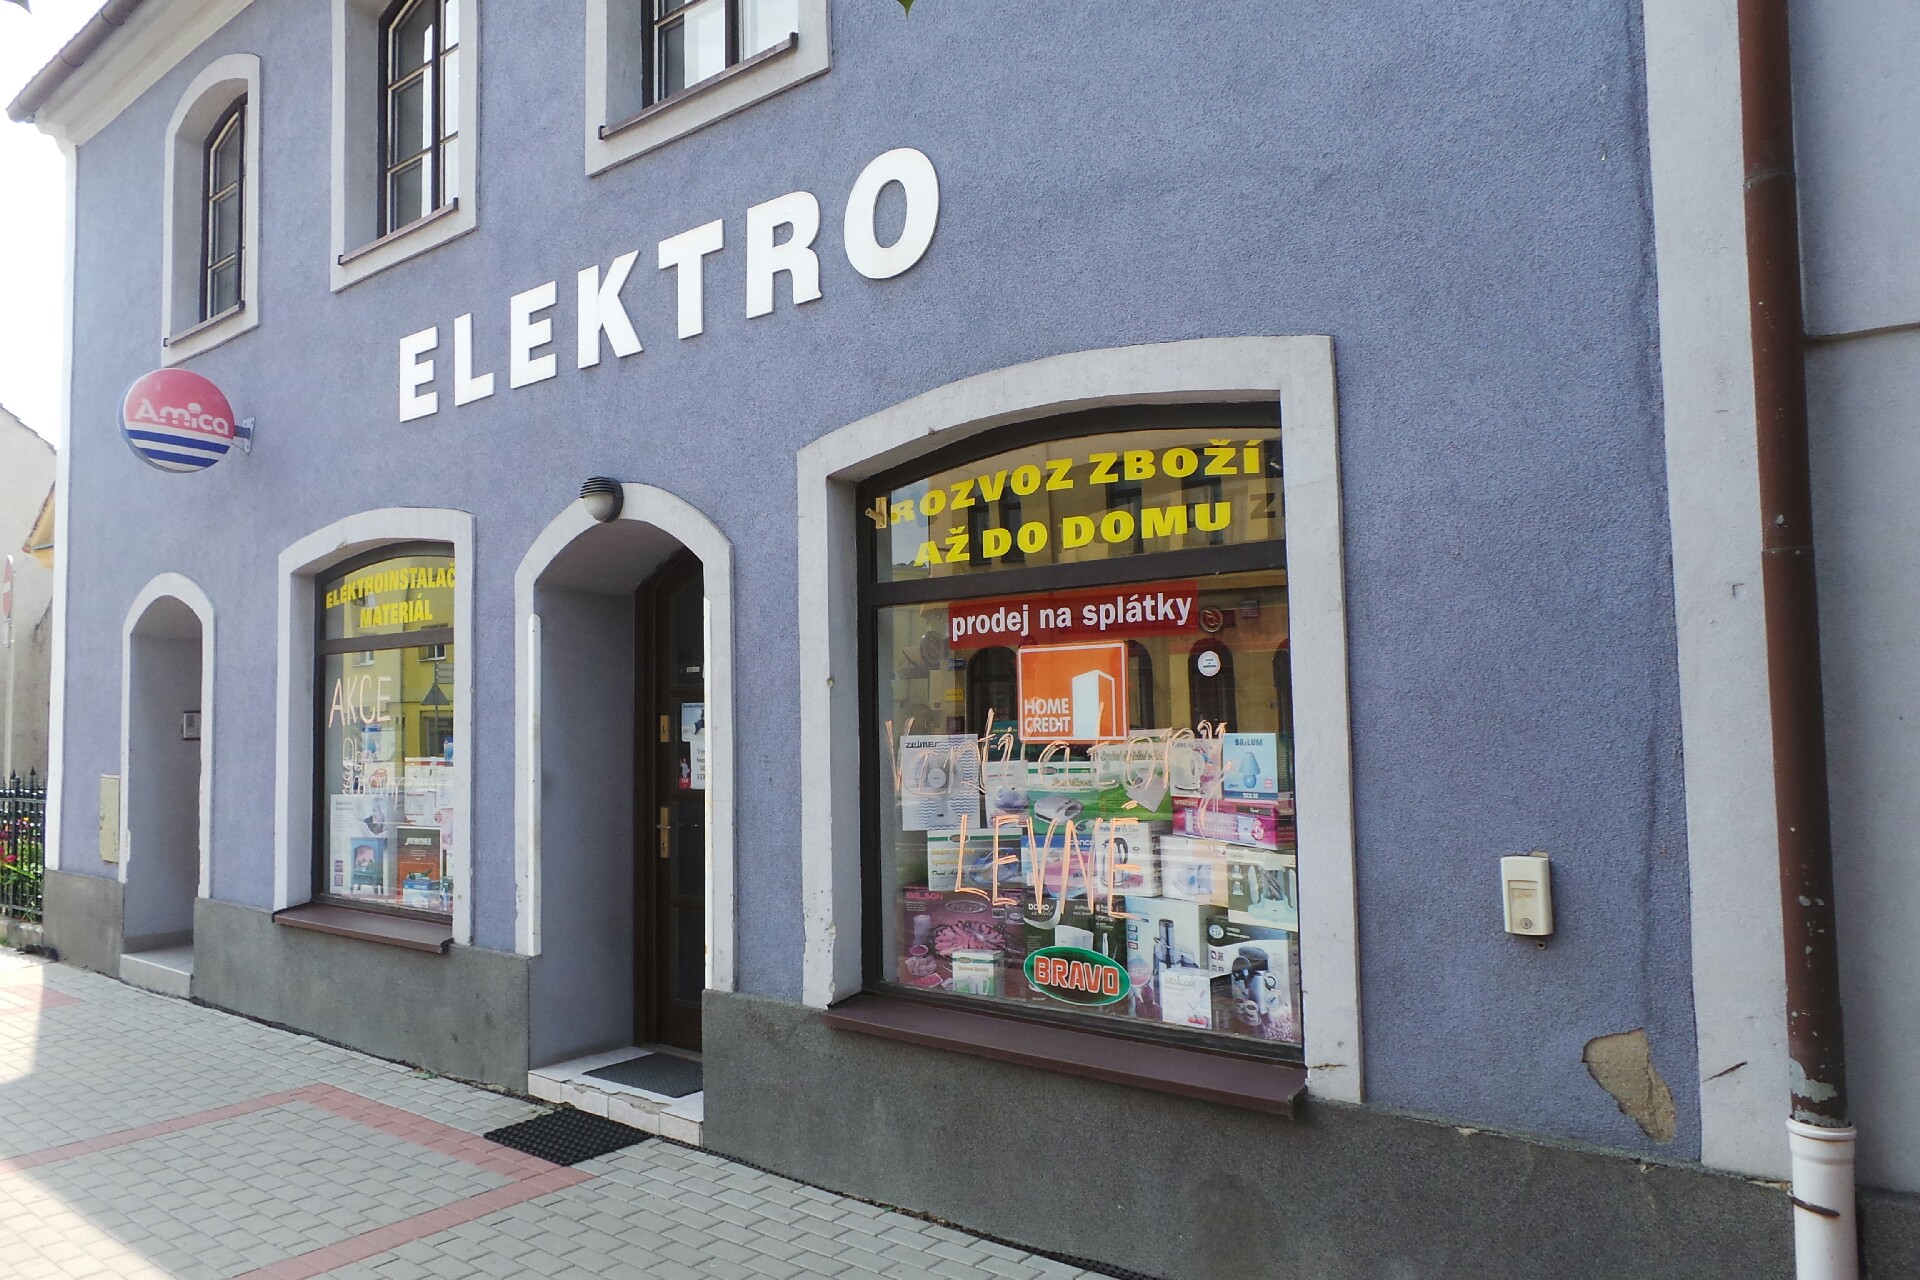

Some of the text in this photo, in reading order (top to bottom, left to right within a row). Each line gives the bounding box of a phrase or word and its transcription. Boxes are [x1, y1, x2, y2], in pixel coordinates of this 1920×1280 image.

[400, 147, 940, 422] ELEKTRO
[134, 398, 229, 435] Amica
[891, 439, 1263, 526] ROZVOZ ZBOŽÍ
[914, 527, 970, 567] AŽ
[982, 521, 1048, 558] DO
[1063, 502, 1232, 548] DOMU
[360, 593, 433, 628] MATERIÁL
[953, 592, 1192, 642] prodej na splátky
[328, 674, 392, 729] AKCE
[1024, 697, 1070, 715] HOME
[1024, 716, 1071, 733] CREDIT
[905, 740, 940, 749] zelmer
[1028, 903, 1050, 911] DOO
[1034, 955, 1120, 997] BRAVO
[1164, 977, 1195, 987] SENCOR
